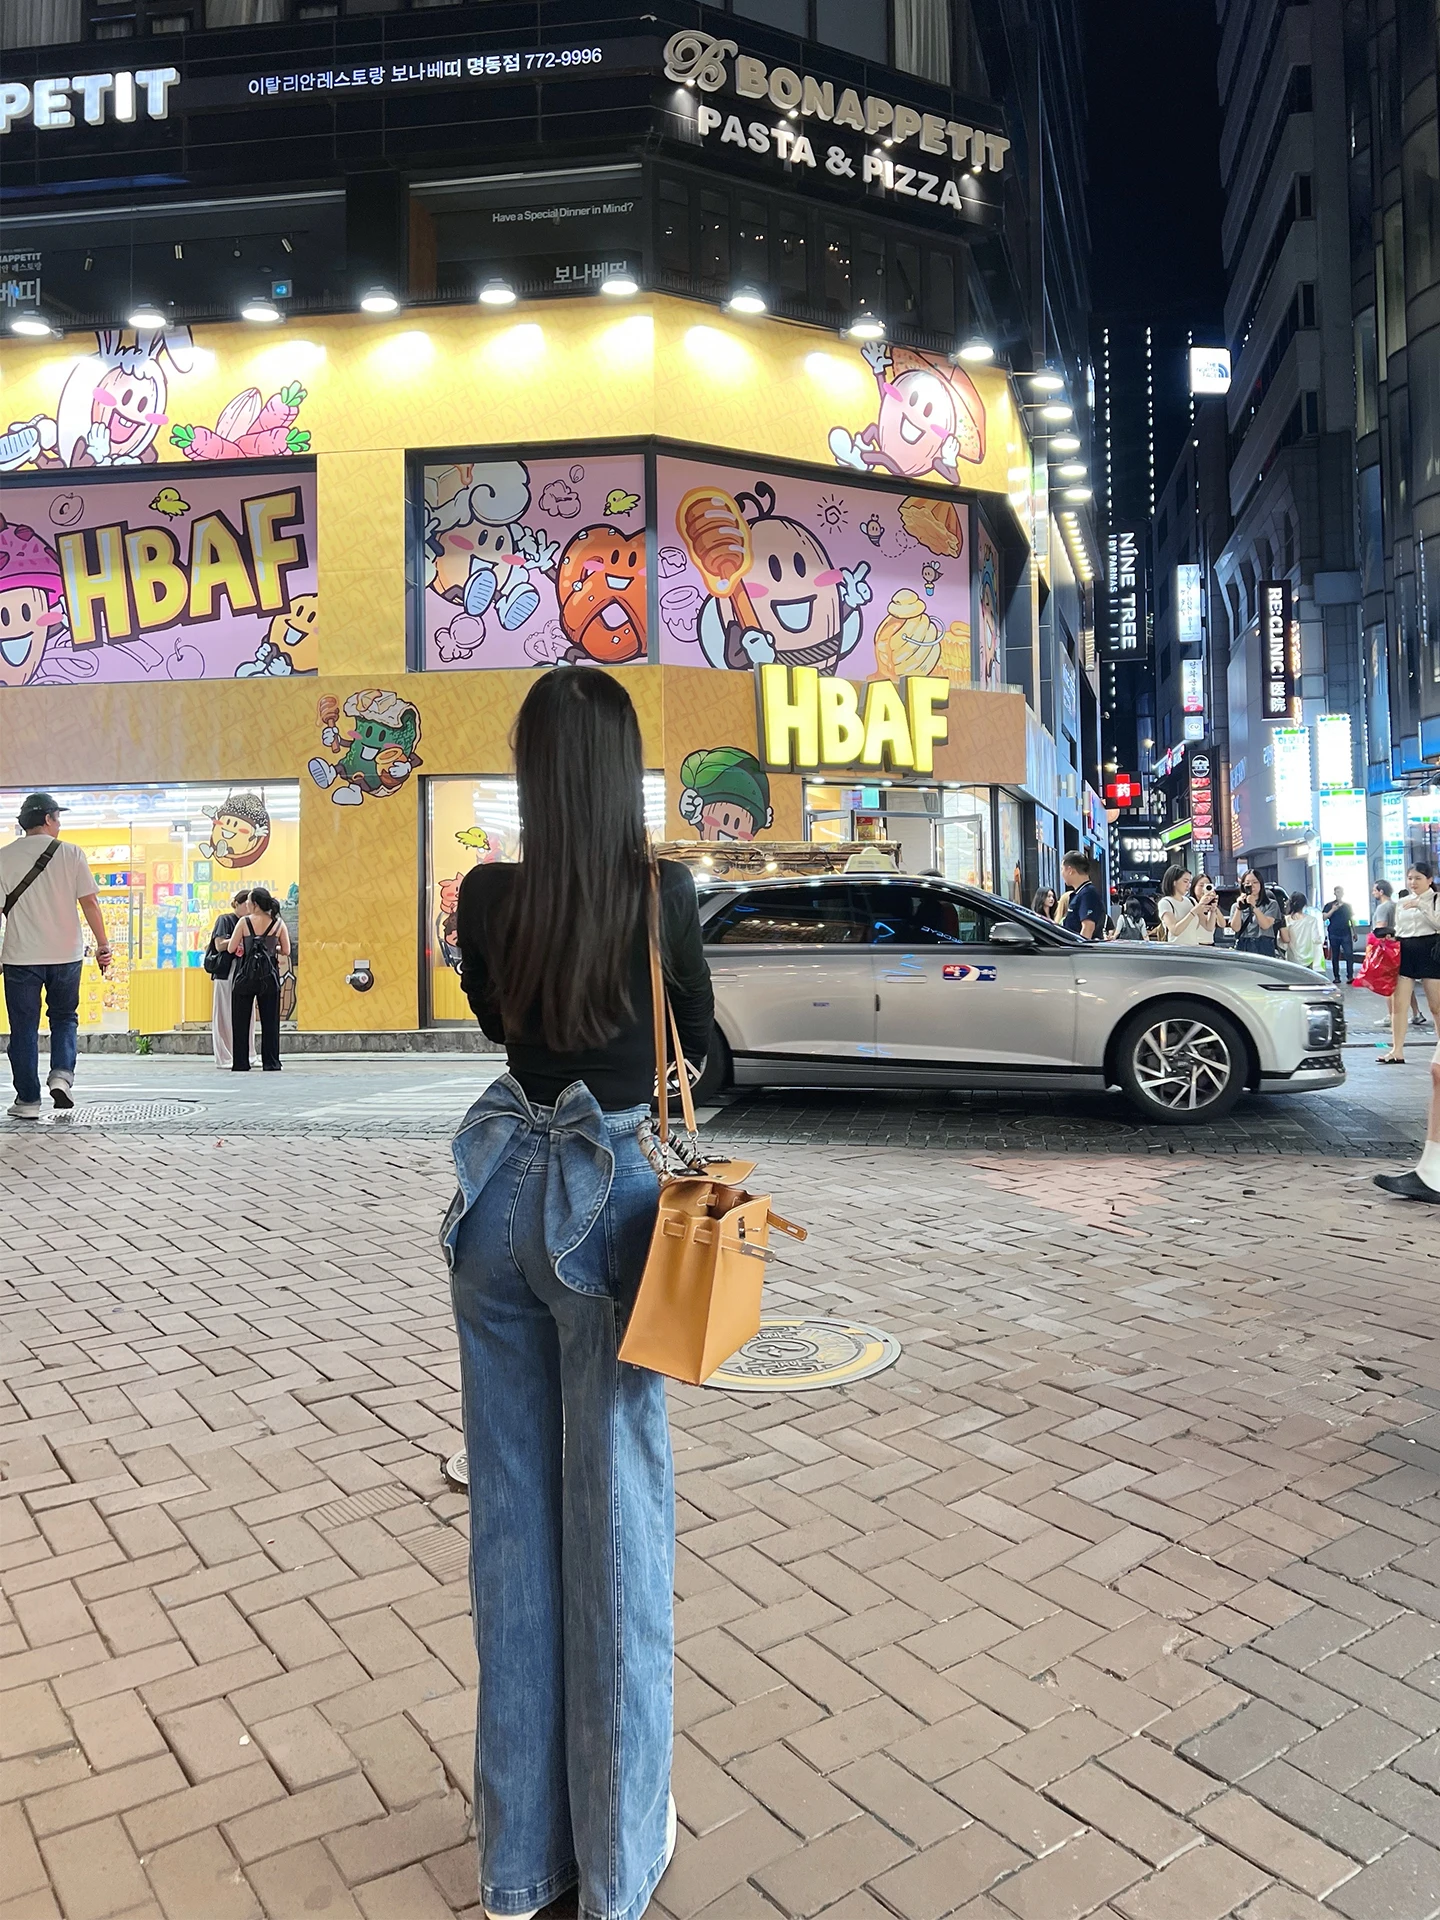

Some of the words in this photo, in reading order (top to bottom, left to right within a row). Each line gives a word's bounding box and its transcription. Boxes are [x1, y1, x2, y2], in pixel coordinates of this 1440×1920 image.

[390, 58, 462, 82] 보나베띠
[466, 52, 521, 76] 명동점
[524, 47, 603, 70] 772-9996
[735, 54, 1011, 172] BONAPPETIT
[697, 105, 817, 168] PASTA
[825, 145, 857, 178] &
[862, 154, 964, 211] PIZZA
[492, 211, 517, 223] Have
[517, 213, 524, 221] a
[524, 208, 559, 222] Special
[559, 207, 591, 218] Dinner
[592, 204, 601, 214] in
[602, 202, 634, 214] Mind?
[56, 487, 308, 651] HBAF
[1108, 539, 1118, 553] BY
[1108, 555, 1119, 593] PARNAS
[1120, 592, 1137, 650] TREE
[1268, 587, 1284, 673] RE:CLINIC
[755, 663, 950, 778] HBAF
[1123, 838, 1150, 850] THE
[208, 880, 279, 892] ORIGINAL
